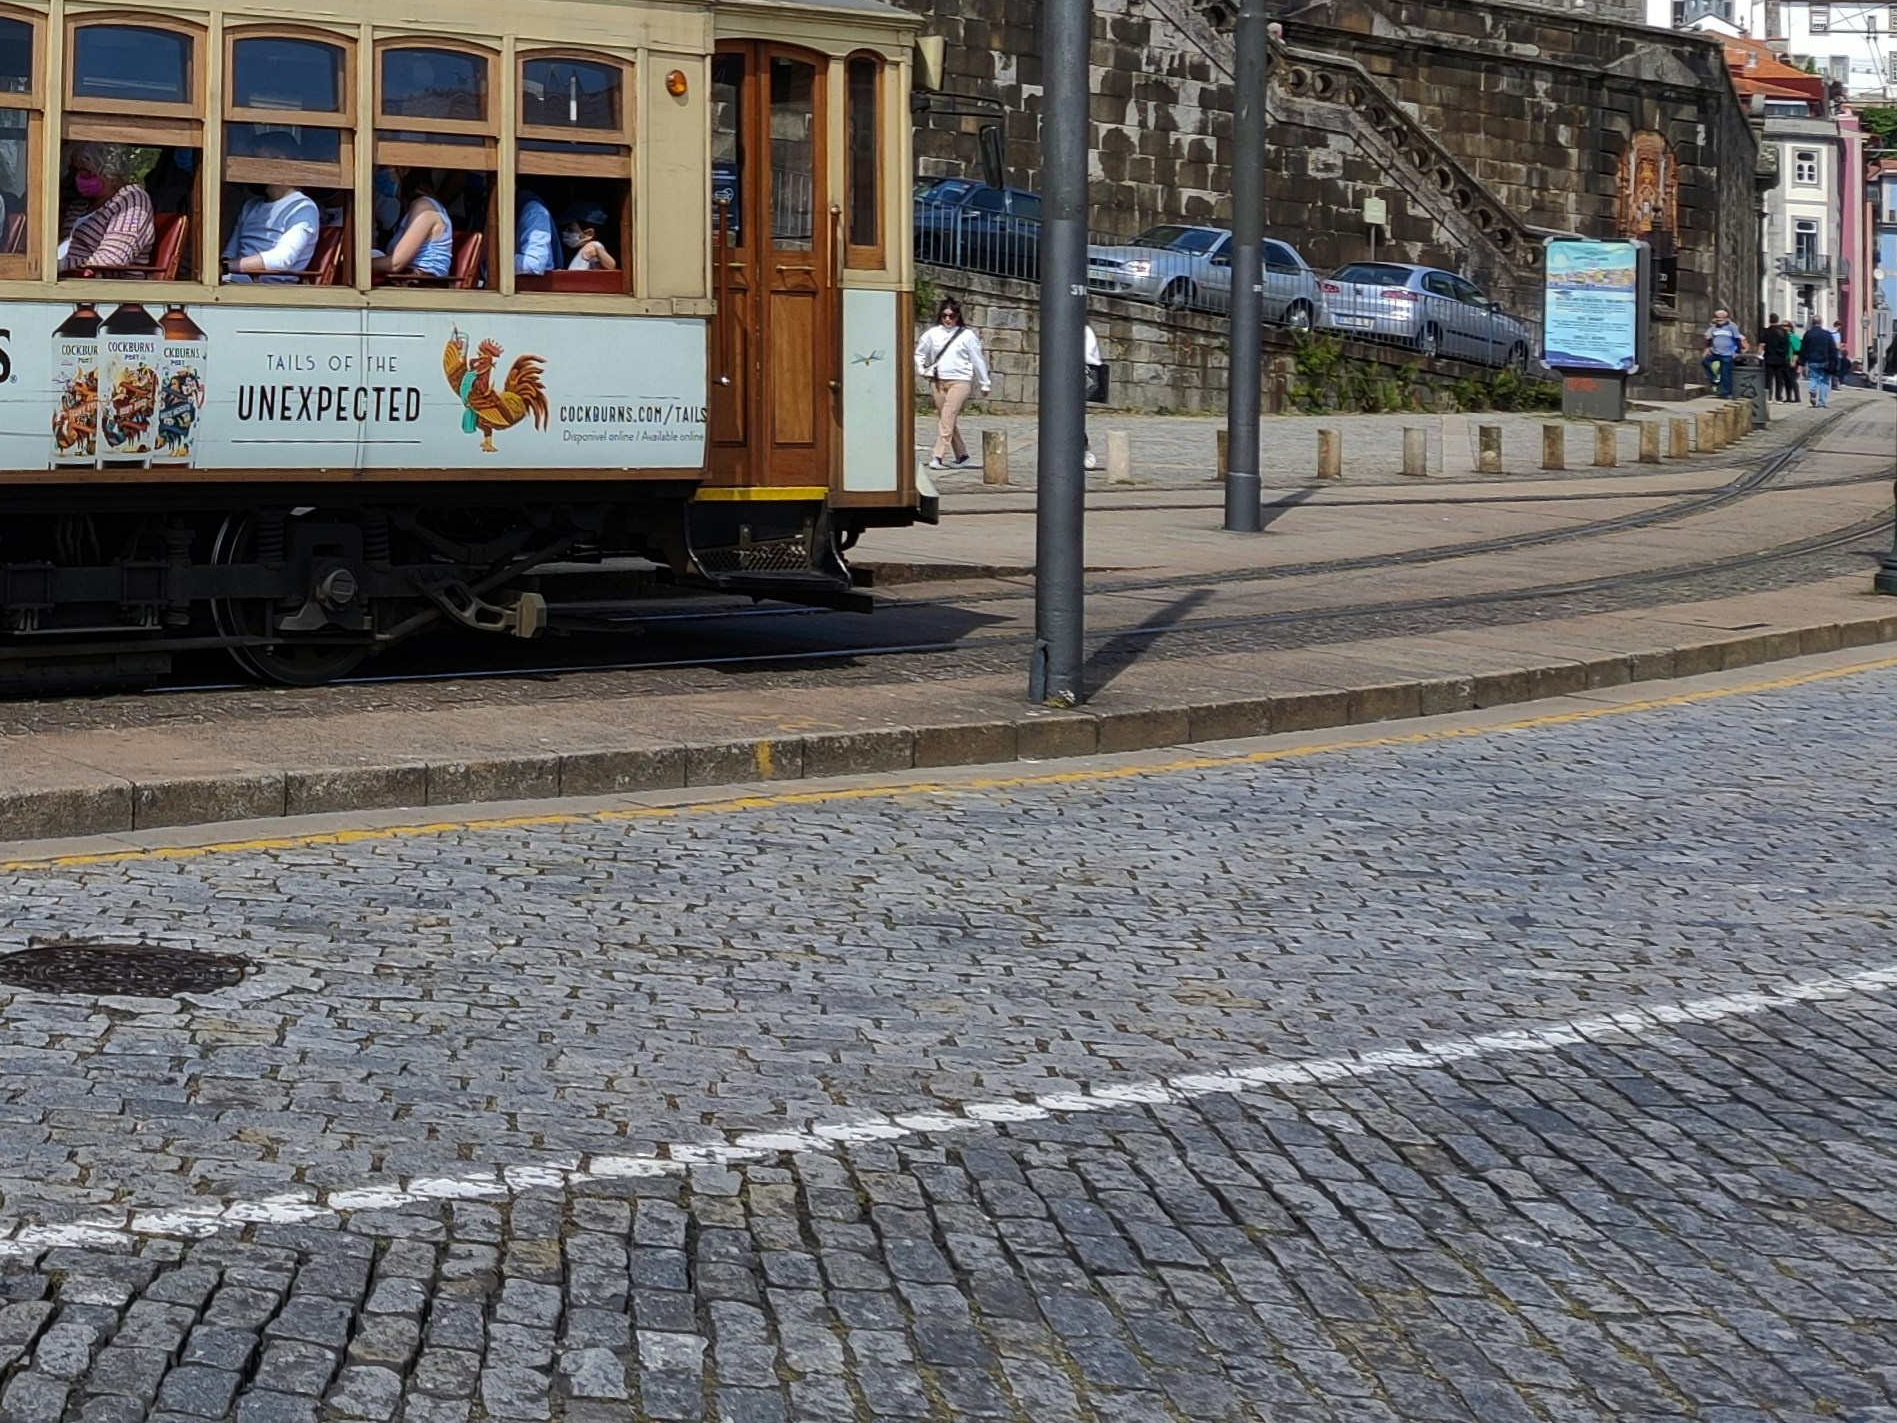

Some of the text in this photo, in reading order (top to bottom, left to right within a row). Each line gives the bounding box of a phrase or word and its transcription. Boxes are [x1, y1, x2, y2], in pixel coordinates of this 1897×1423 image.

[266, 354, 398, 372] TAILS OF THE
[237, 384, 421, 423] UNEXPECTED
[560, 404, 708, 425] COCKBURNS.COM/TAILS
[608, 431, 634, 442] online
[641, 430, 678, 442] Available
[679, 431, 705, 442] online
